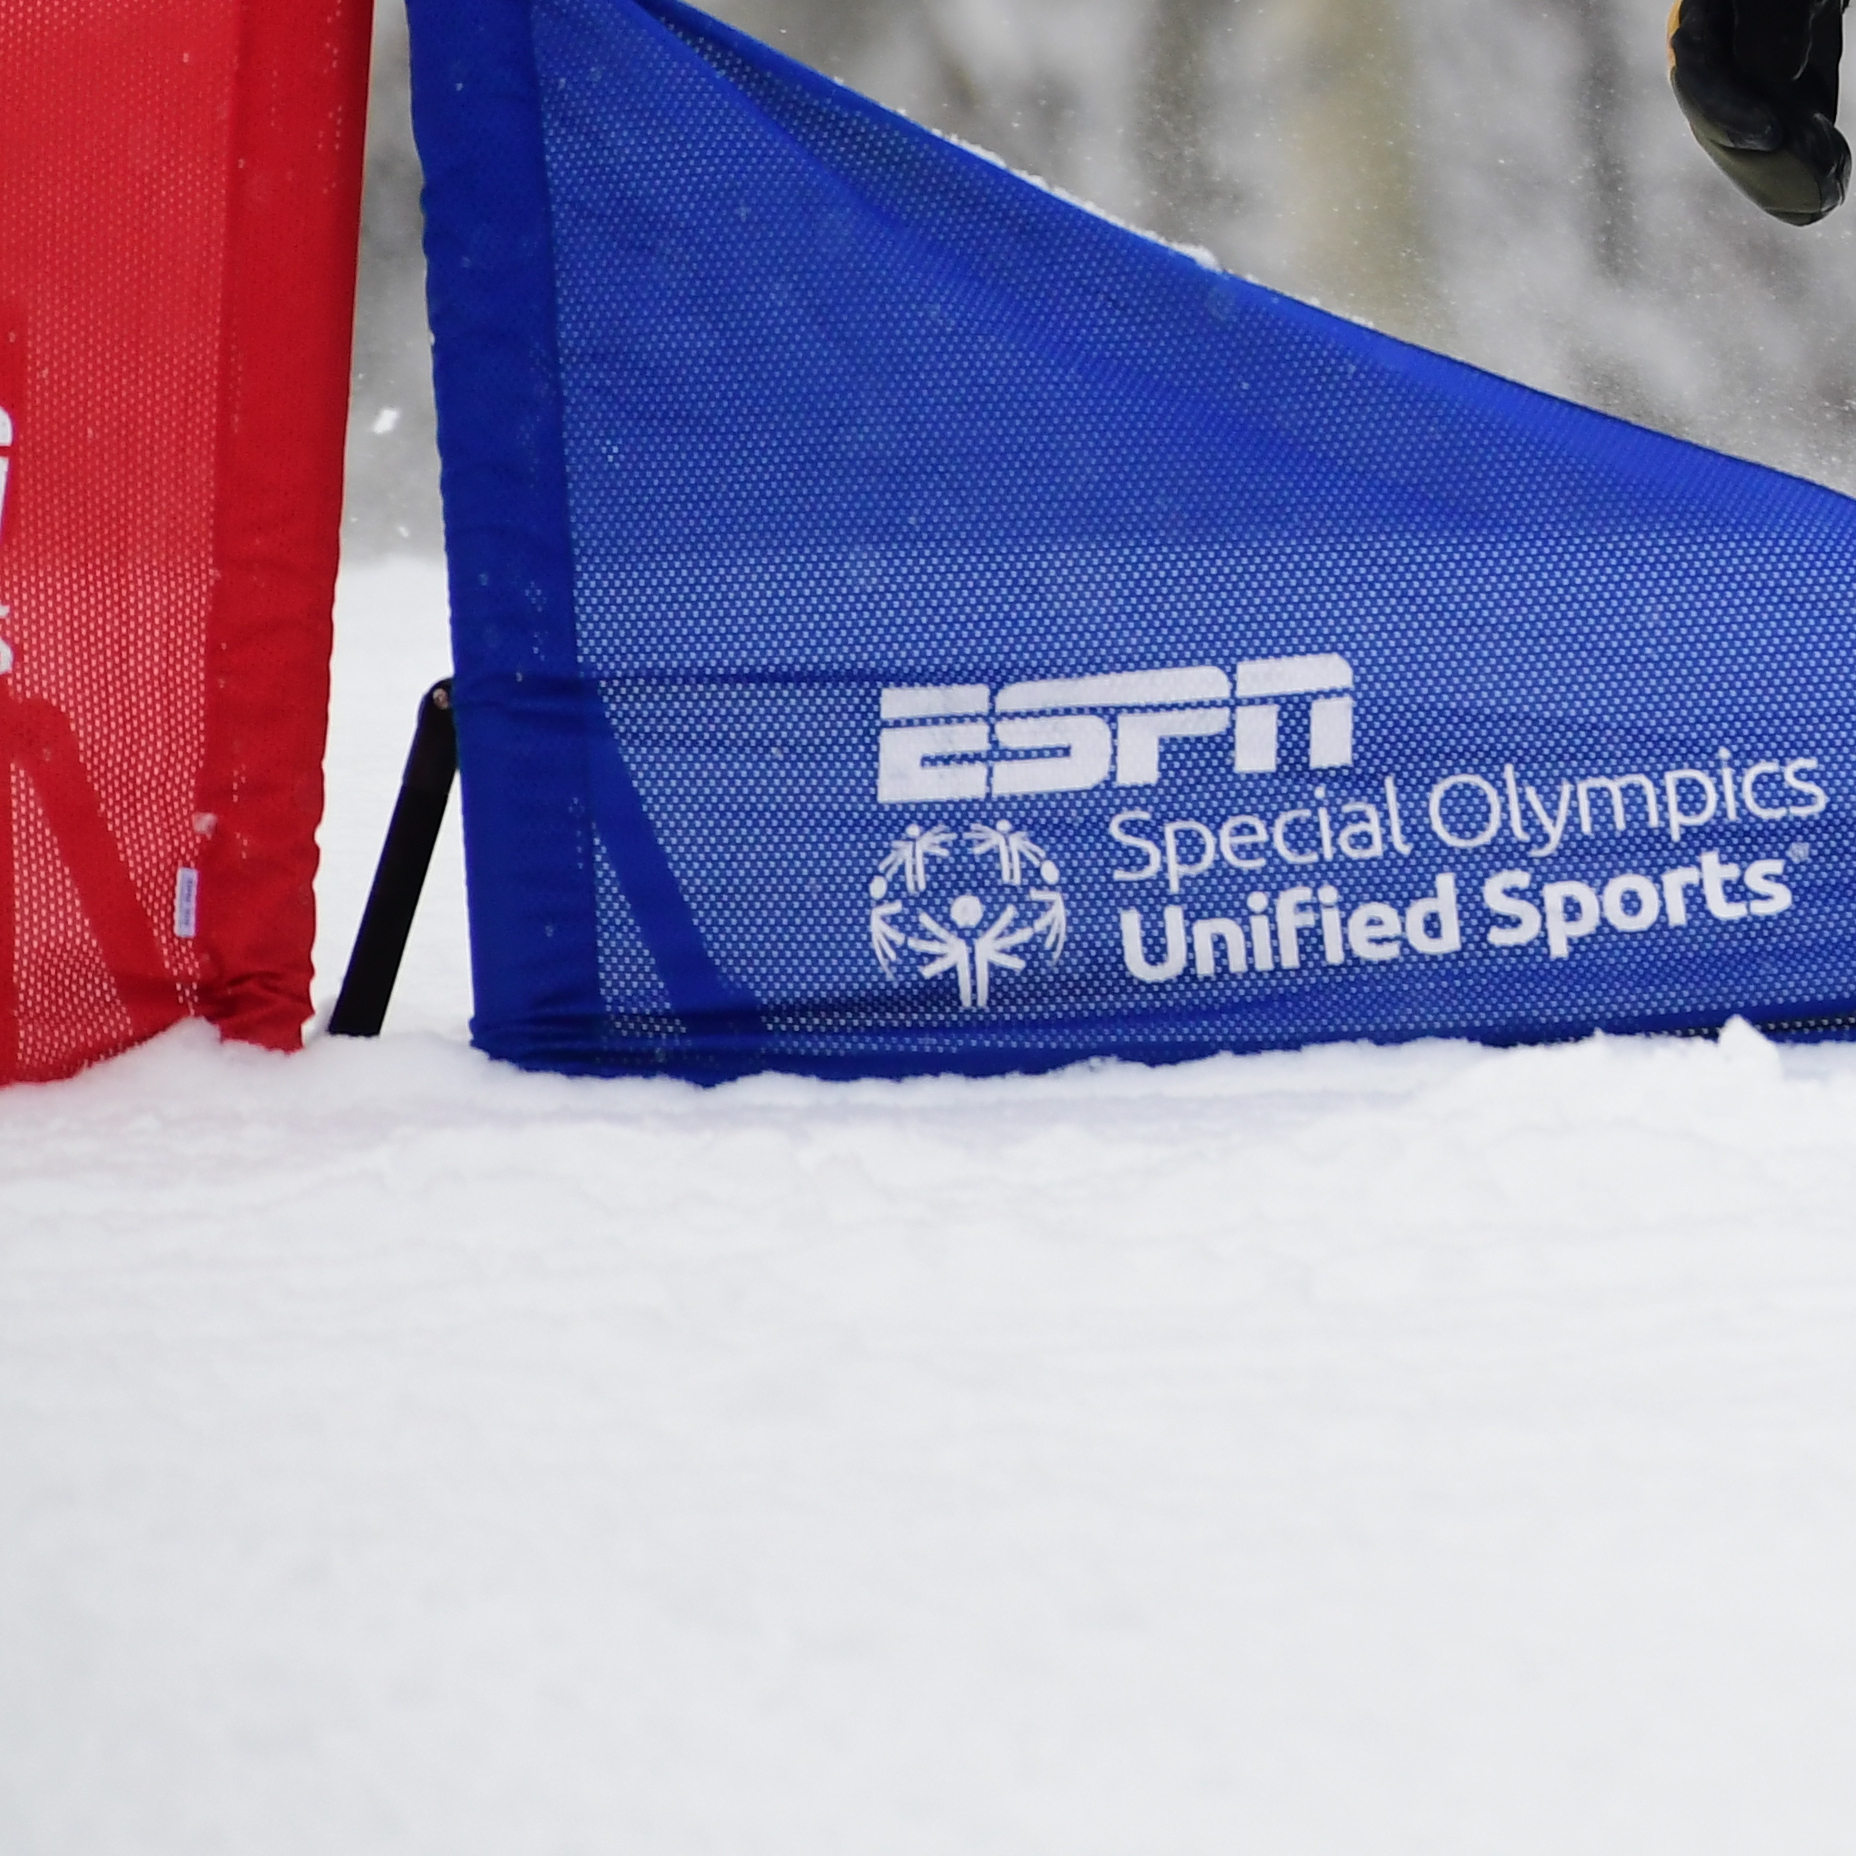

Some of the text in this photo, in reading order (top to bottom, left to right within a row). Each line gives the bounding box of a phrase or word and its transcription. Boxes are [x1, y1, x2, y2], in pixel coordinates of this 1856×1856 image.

[877, 652, 1353, 803] ESPN
[1108, 747, 1829, 892] Special Olympics
[1119, 852, 1793, 983] Unified Sports
